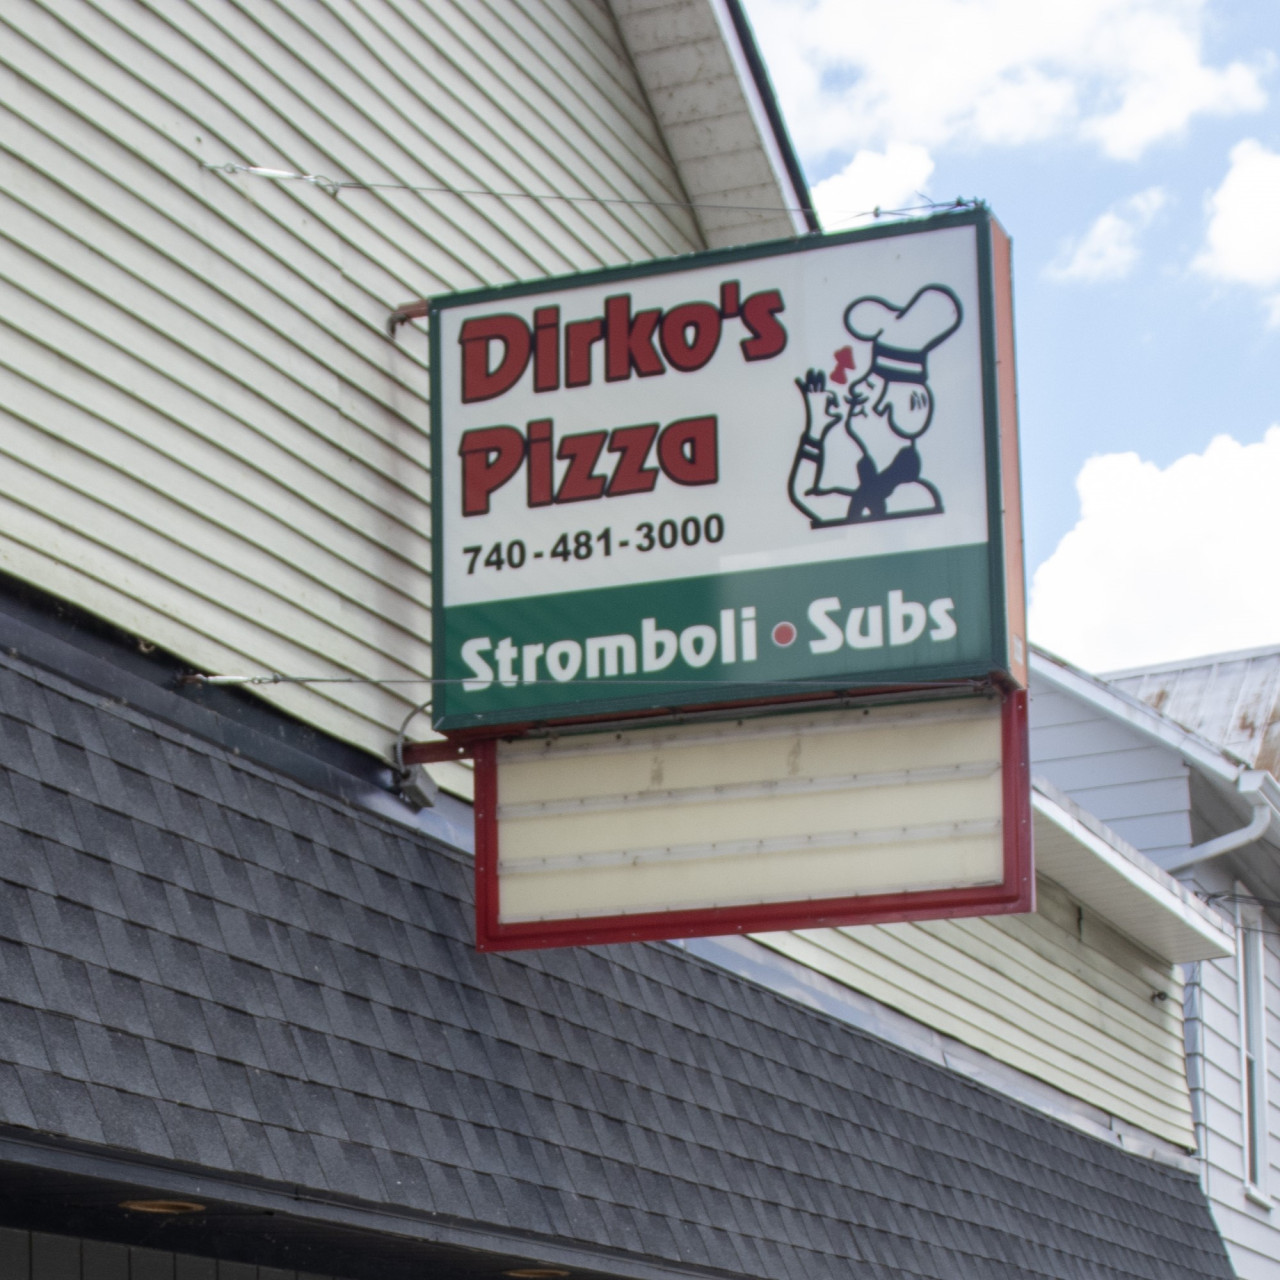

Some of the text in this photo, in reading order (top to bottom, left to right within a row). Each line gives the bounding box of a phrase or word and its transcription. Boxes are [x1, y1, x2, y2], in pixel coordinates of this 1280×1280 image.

[458, 279, 788, 404] Dirko's
[458, 415, 719, 518] Pizza
[461, 590, 958, 692] Stromboli Subs
